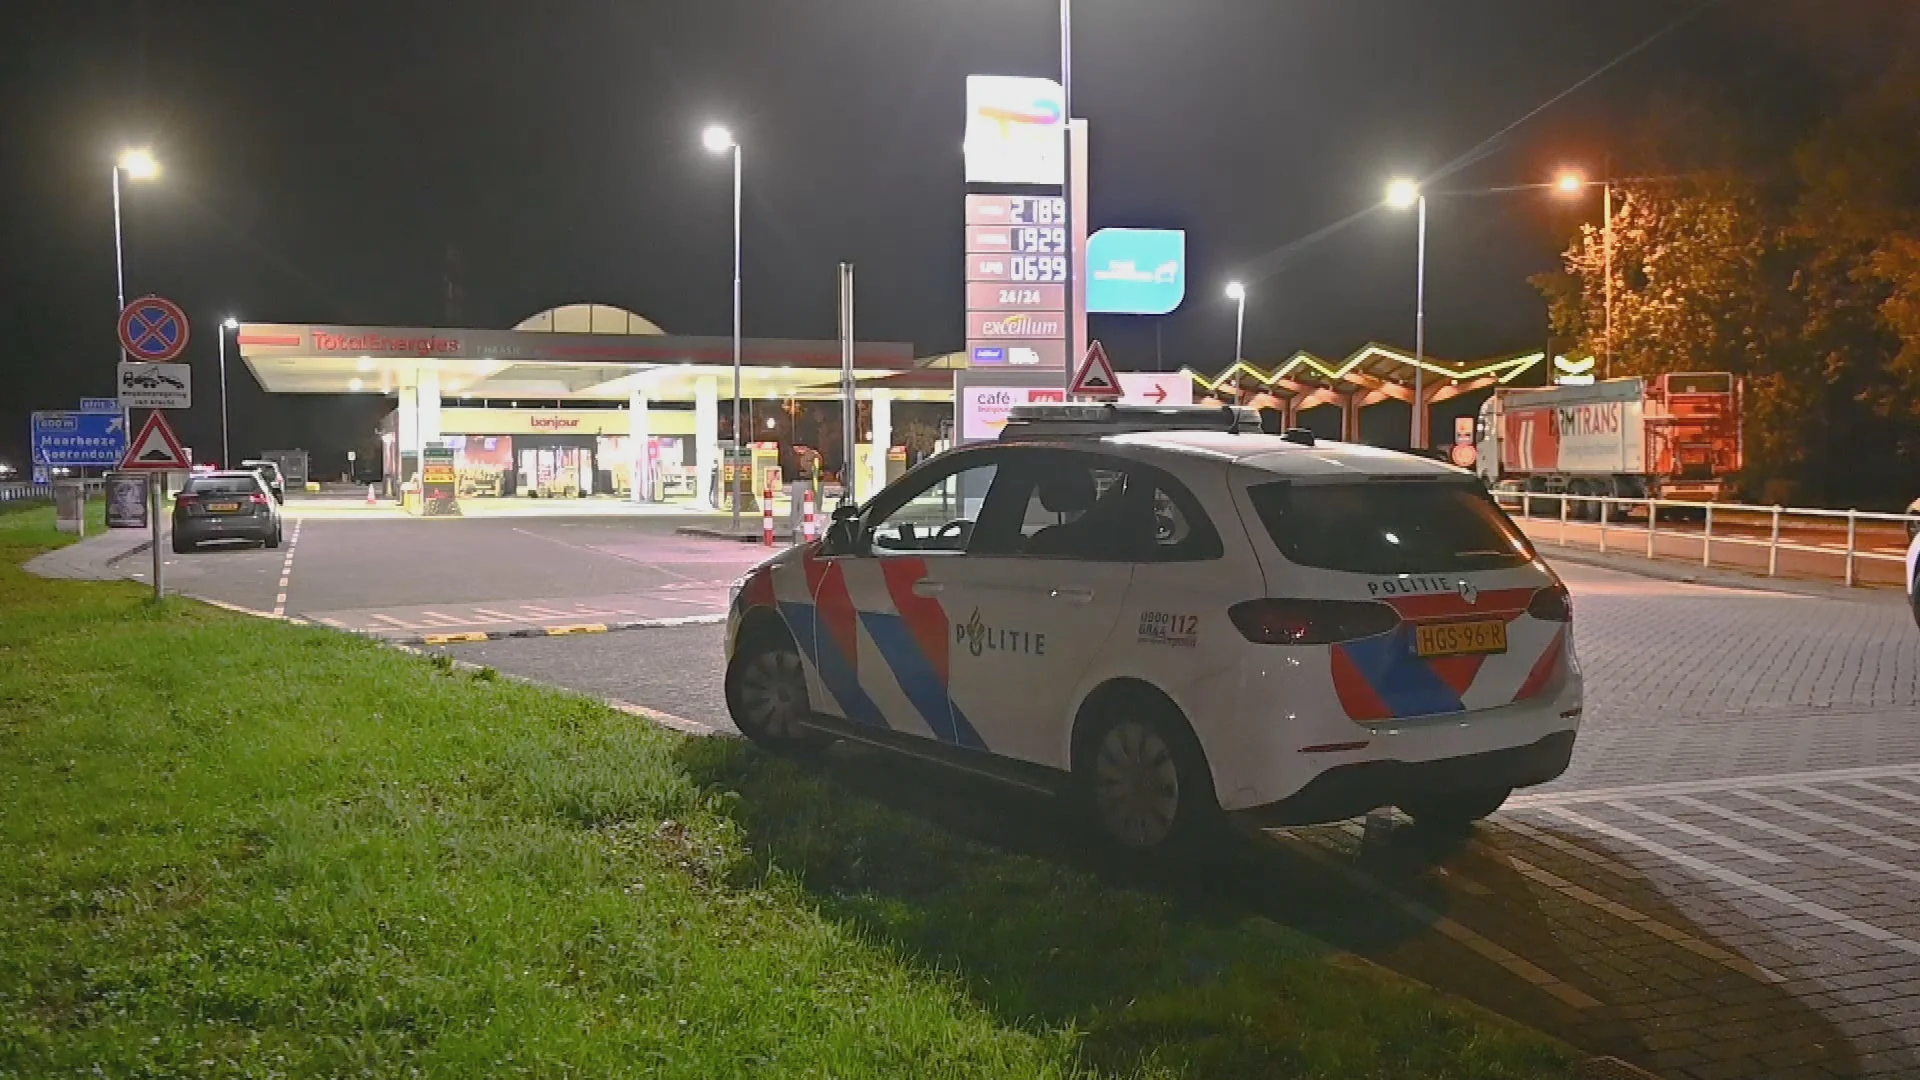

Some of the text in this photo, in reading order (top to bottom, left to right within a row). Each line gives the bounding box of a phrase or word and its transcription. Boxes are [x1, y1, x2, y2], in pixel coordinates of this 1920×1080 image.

[1018, 226, 1066, 252] 1929
[1010, 256, 1067, 280] 0699
[999, 289, 1041, 304] 24/24
[982, 316, 1058, 335] excellium
[312, 330, 461, 356] TotalEnergies
[977, 391, 1011, 405] café
[530, 415, 580, 430] bonjour
[41, 435, 117, 446] Maarheeze
[1367, 577, 1452, 595] POLITIE
[1170, 614, 1199, 635] 112
